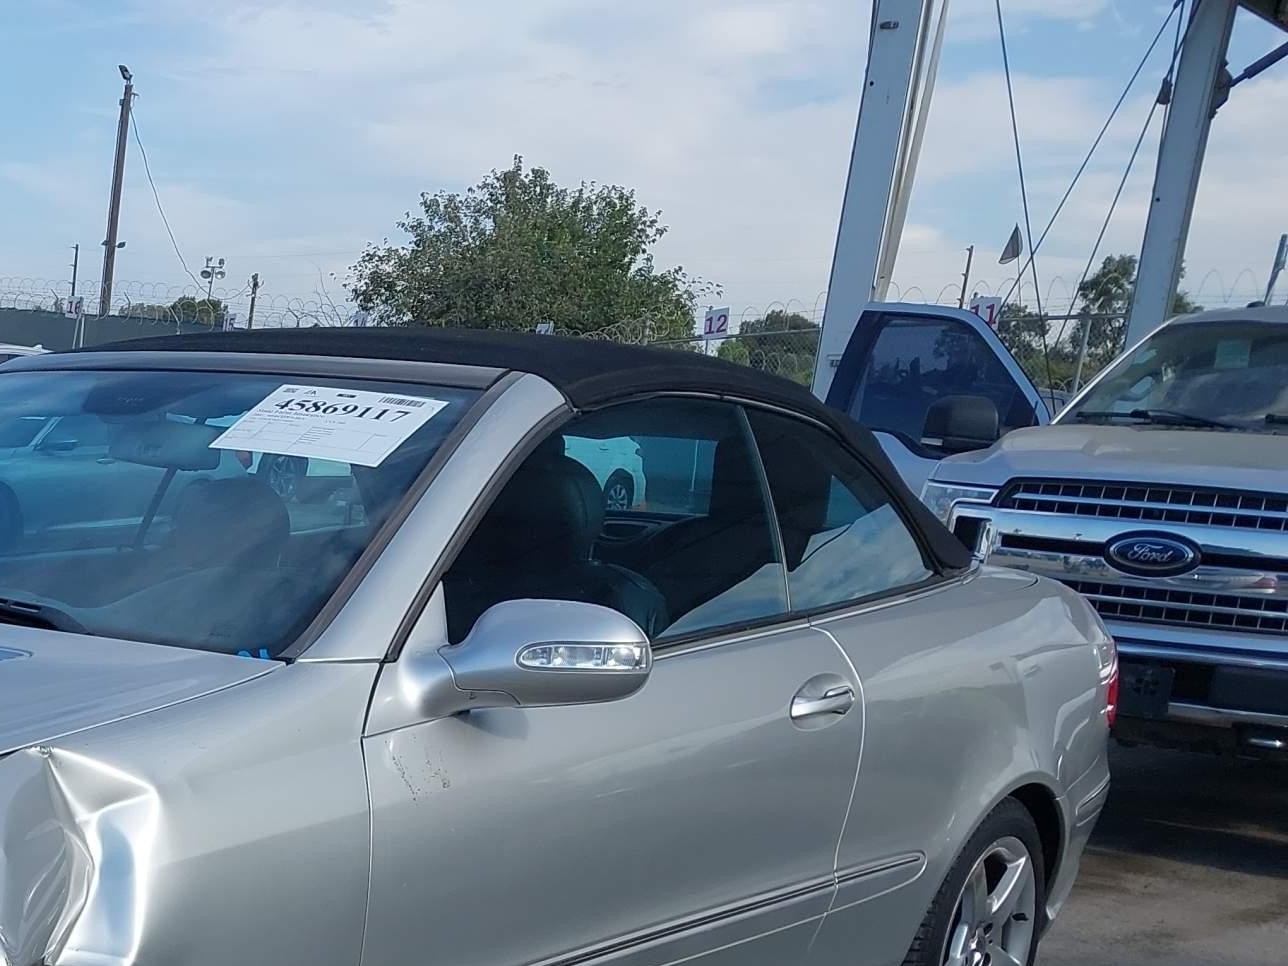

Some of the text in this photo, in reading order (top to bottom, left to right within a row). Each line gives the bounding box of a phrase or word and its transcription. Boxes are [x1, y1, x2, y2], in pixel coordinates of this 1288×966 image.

[704, 314, 728, 335] 12
[274, 398, 412, 423] 45869117
[1128, 543, 1173, 561] Ford
